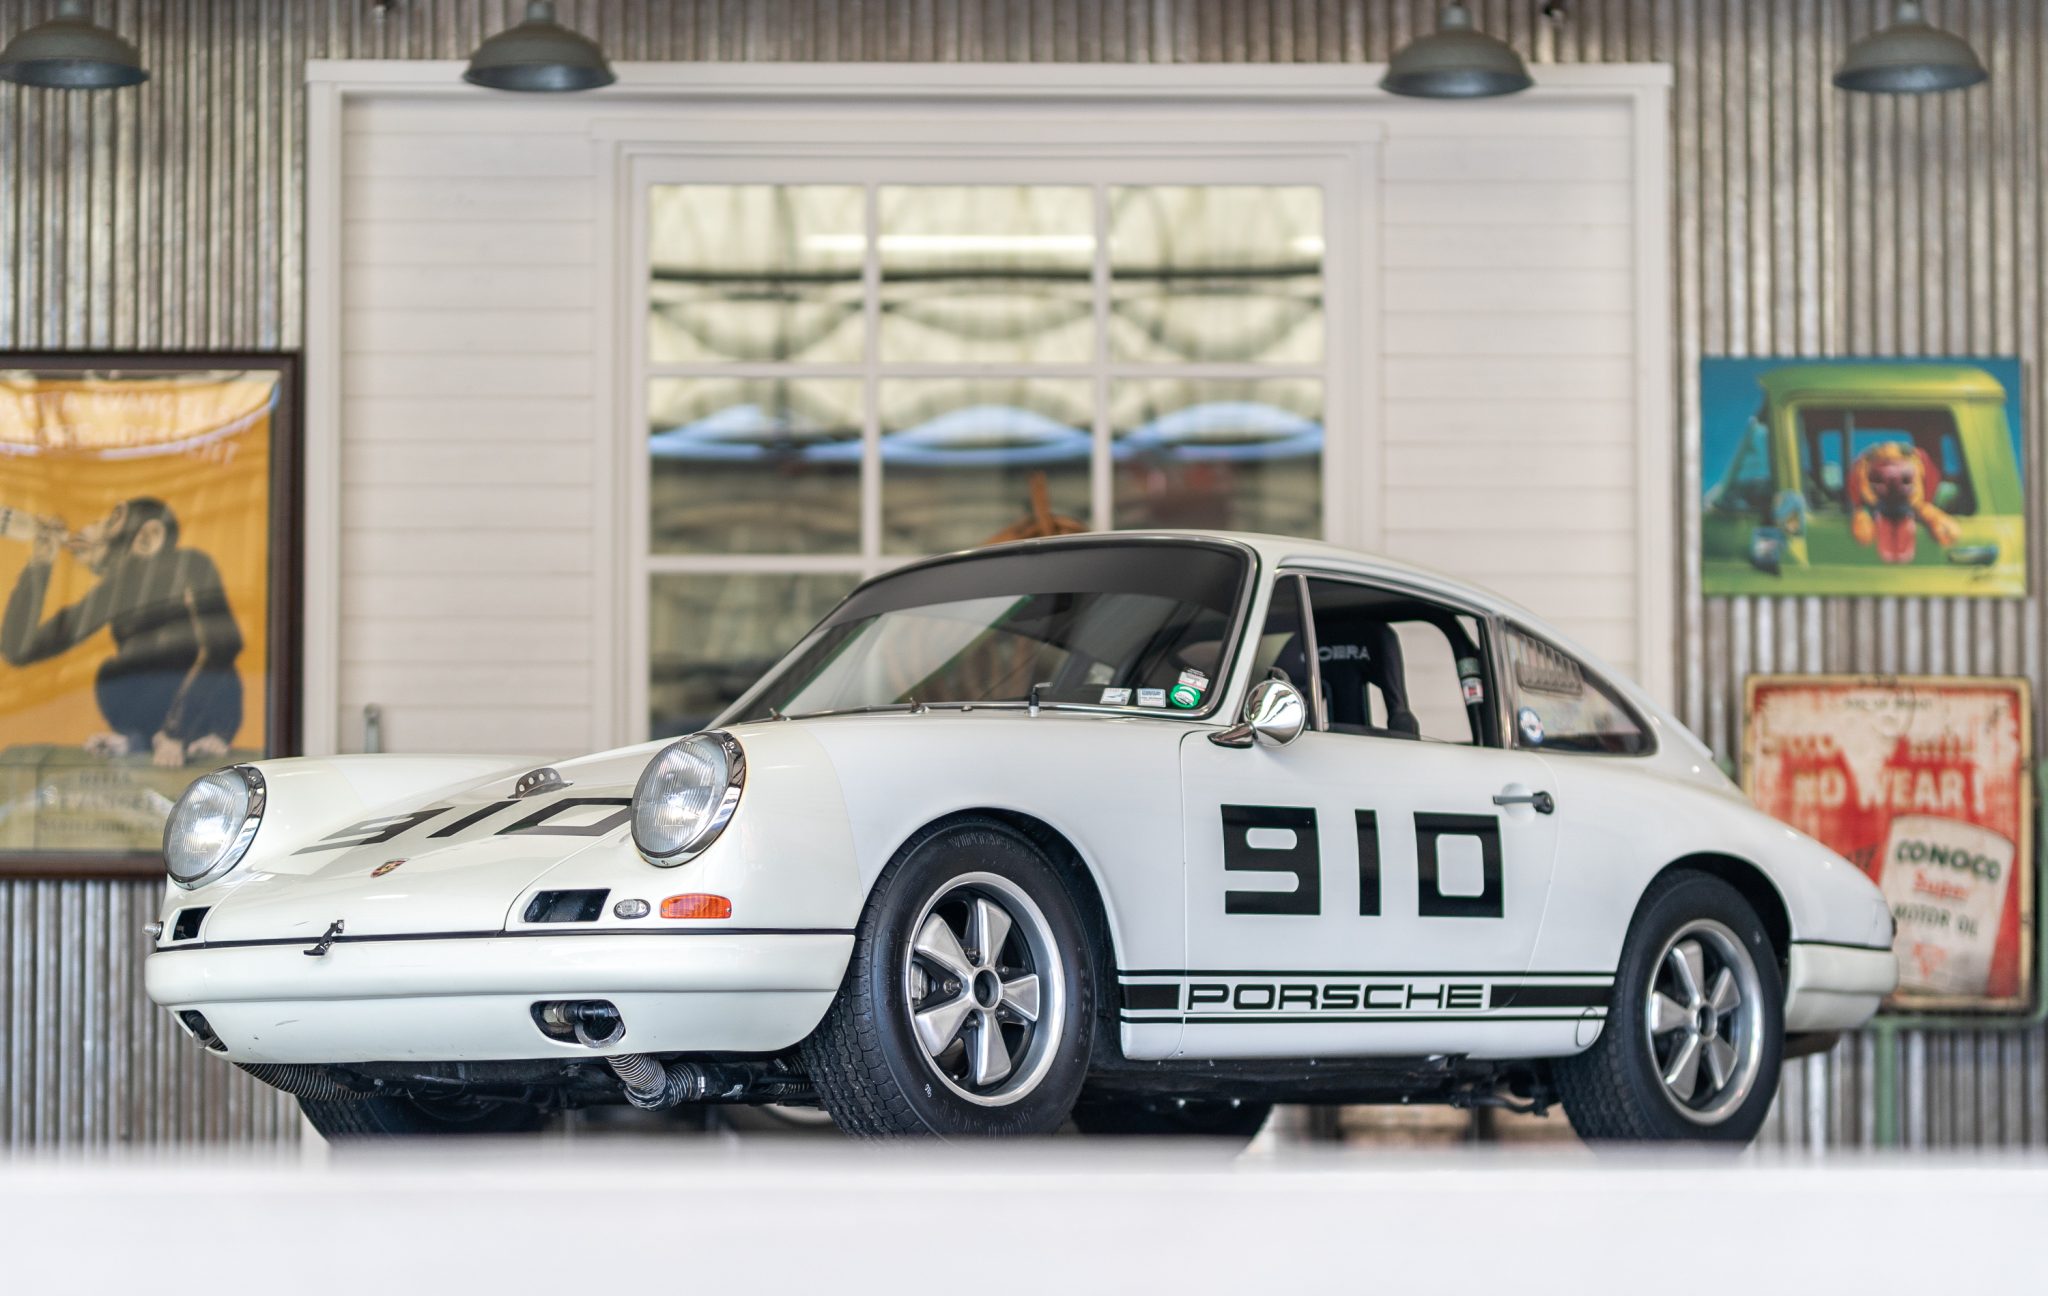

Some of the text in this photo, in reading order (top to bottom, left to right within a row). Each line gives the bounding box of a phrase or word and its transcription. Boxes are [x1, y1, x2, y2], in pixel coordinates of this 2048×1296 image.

[290, 797, 633, 856] 910
[1220, 803, 1505, 918] 910
[1896, 840, 2001, 883] CONOCO
[1894, 902, 1950, 927] MOTOR
[1186, 983, 1485, 1011] PORSCHE
